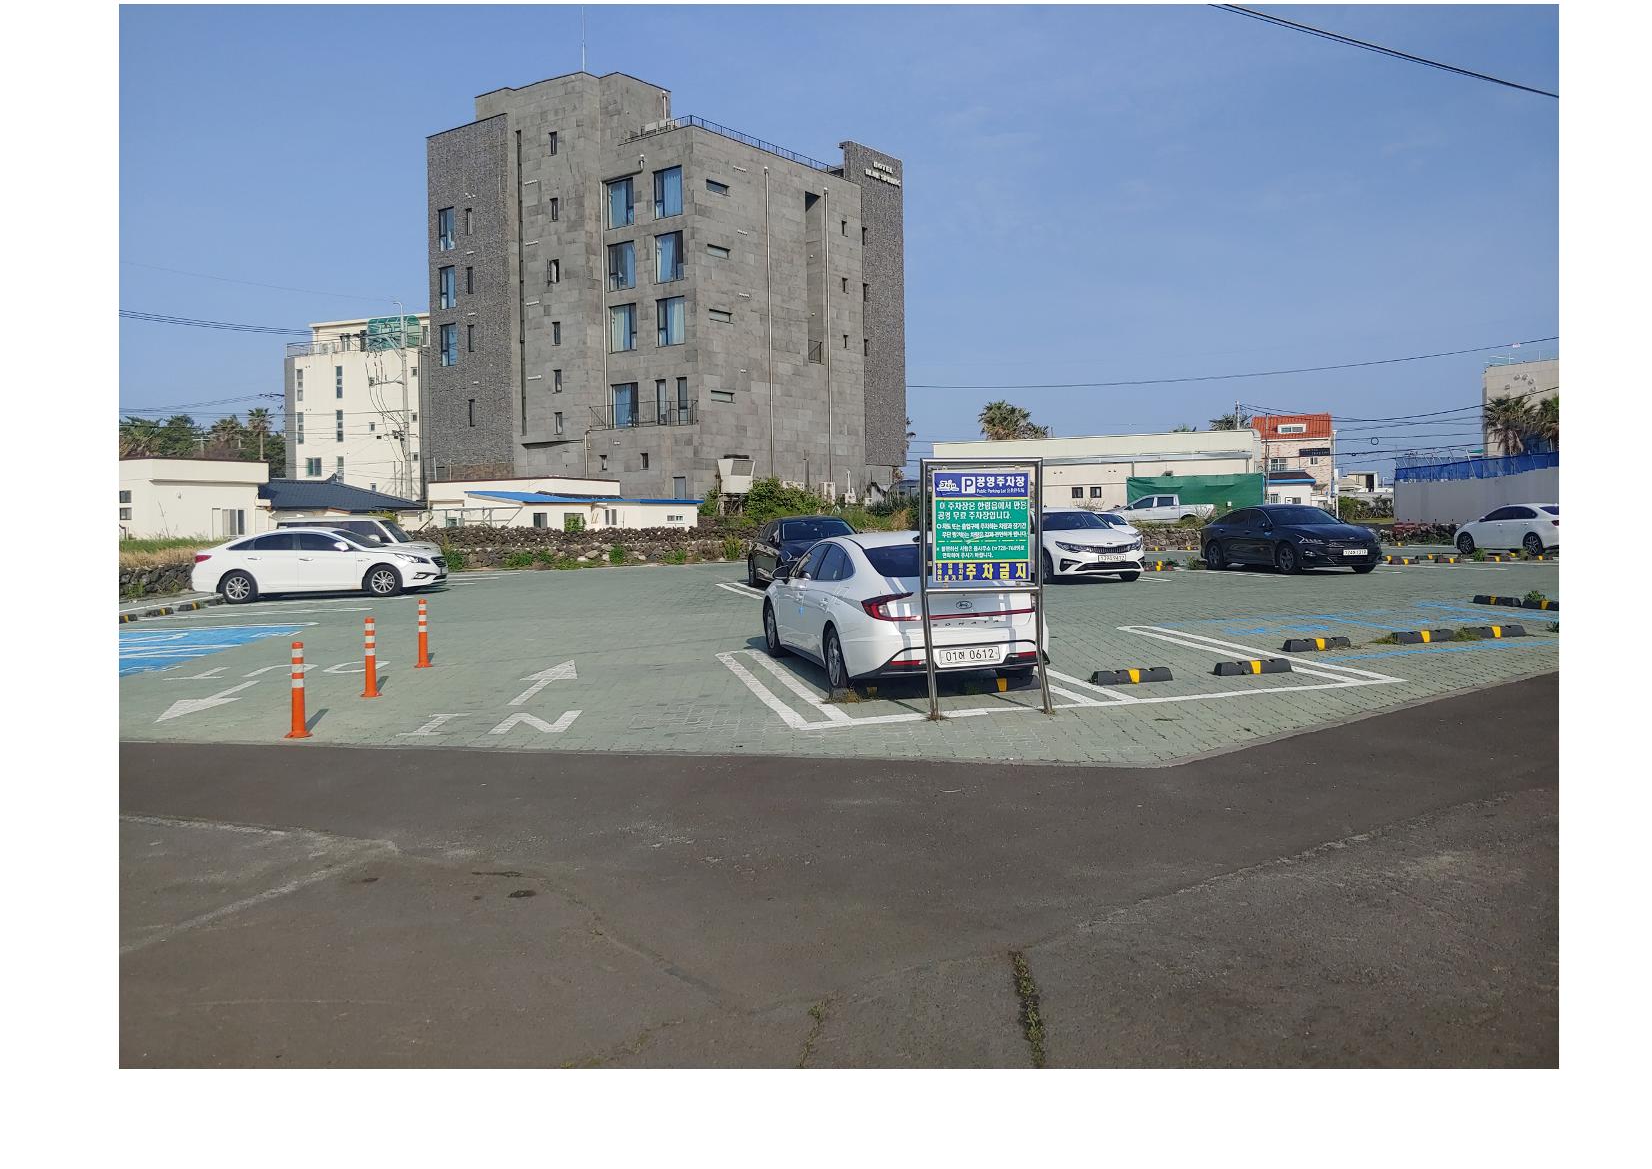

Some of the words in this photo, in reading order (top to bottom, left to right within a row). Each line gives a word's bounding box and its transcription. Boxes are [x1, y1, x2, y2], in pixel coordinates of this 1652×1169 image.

[976, 476, 1025, 487] 공영주차장
[969, 648, 994, 660] 0612
[396, 709, 584, 737] IN
